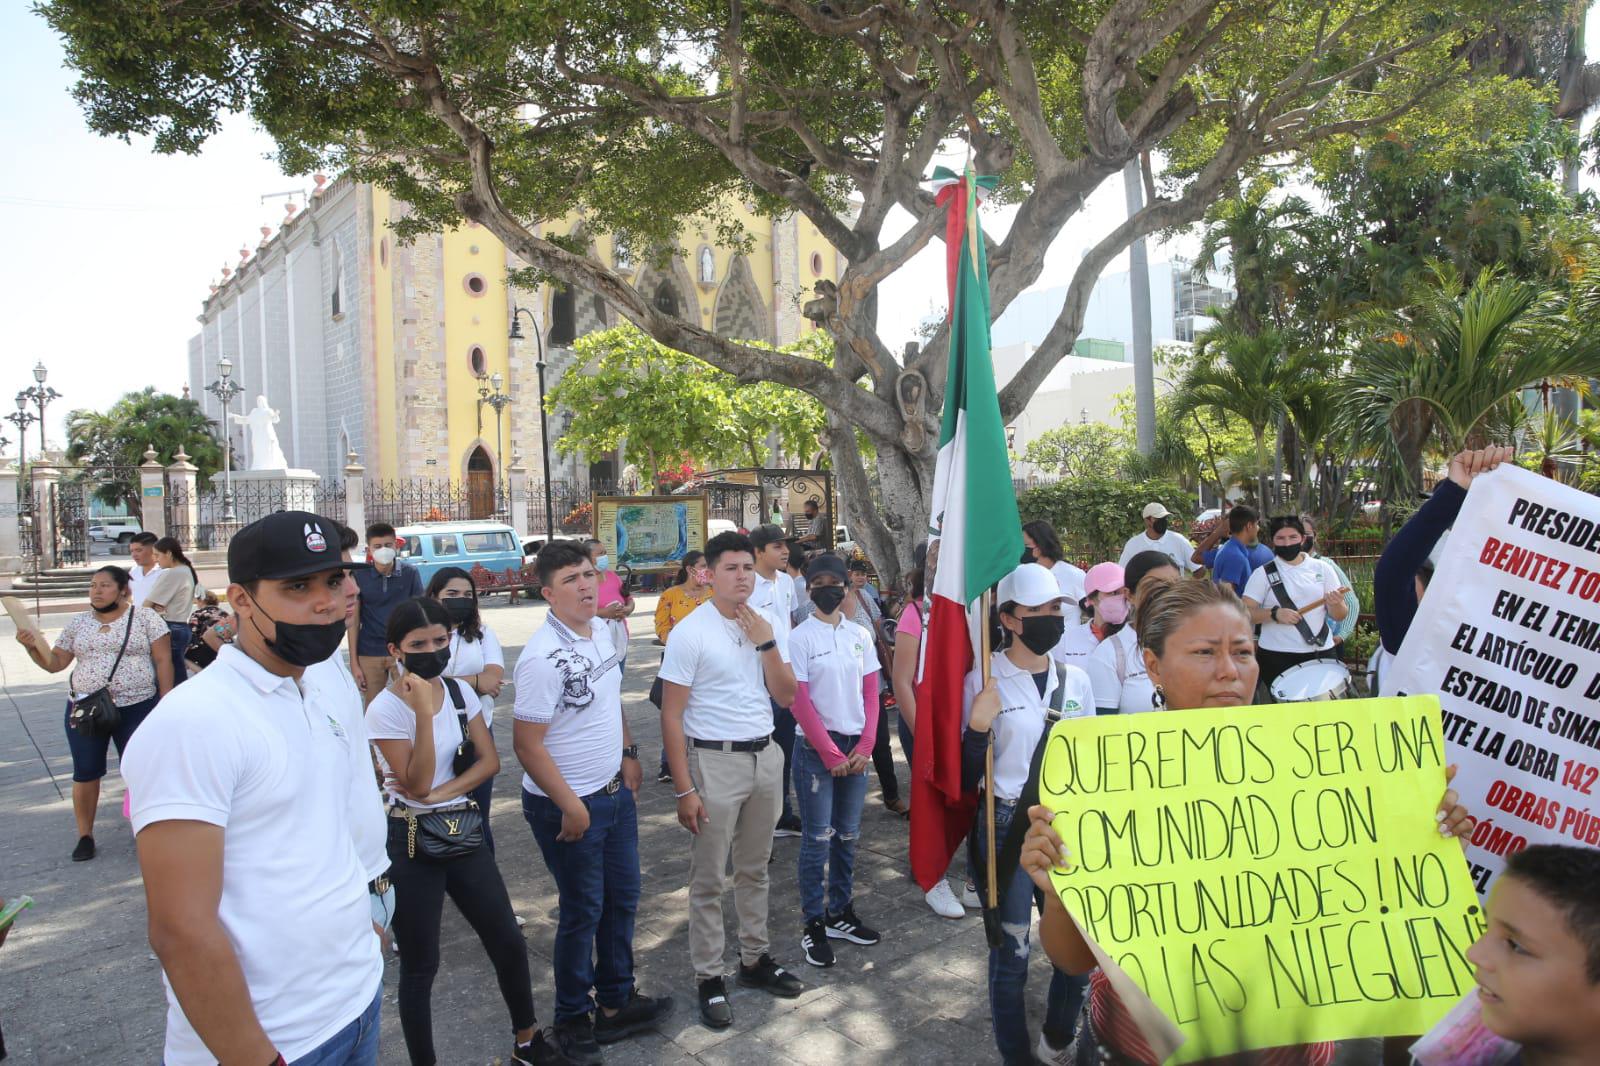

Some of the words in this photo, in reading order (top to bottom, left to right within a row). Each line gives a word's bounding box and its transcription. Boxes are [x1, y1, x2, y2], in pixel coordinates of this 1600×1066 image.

[1508, 498, 1600, 554] PRESIDE
[1479, 536, 1571, 590] BENITEZ
[1491, 589, 1525, 622] EN
[1519, 601, 1550, 632] EL
[1450, 622, 1478, 655] EL
[1475, 632, 1579, 689] ARTÍCULO
[1440, 665, 1523, 718] ESTADO
[1522, 696, 1550, 729] DE
[1547, 706, 1600, 750] SINA
[1042, 724, 1275, 796] QUEREMOS
[1292, 721, 1362, 780] SER
[1373, 716, 1441, 774] UNA
[1473, 727, 1506, 760] LA
[1504, 739, 1560, 781] OBRA
[1561, 759, 1600, 795] 142
[1291, 786, 1378, 851] CON
[1485, 780, 1561, 830] OBRAS
[1559, 807, 1600, 847] PÚB
[1467, 860, 1493, 895] EL
[1161, 939, 1248, 1024] LAS
